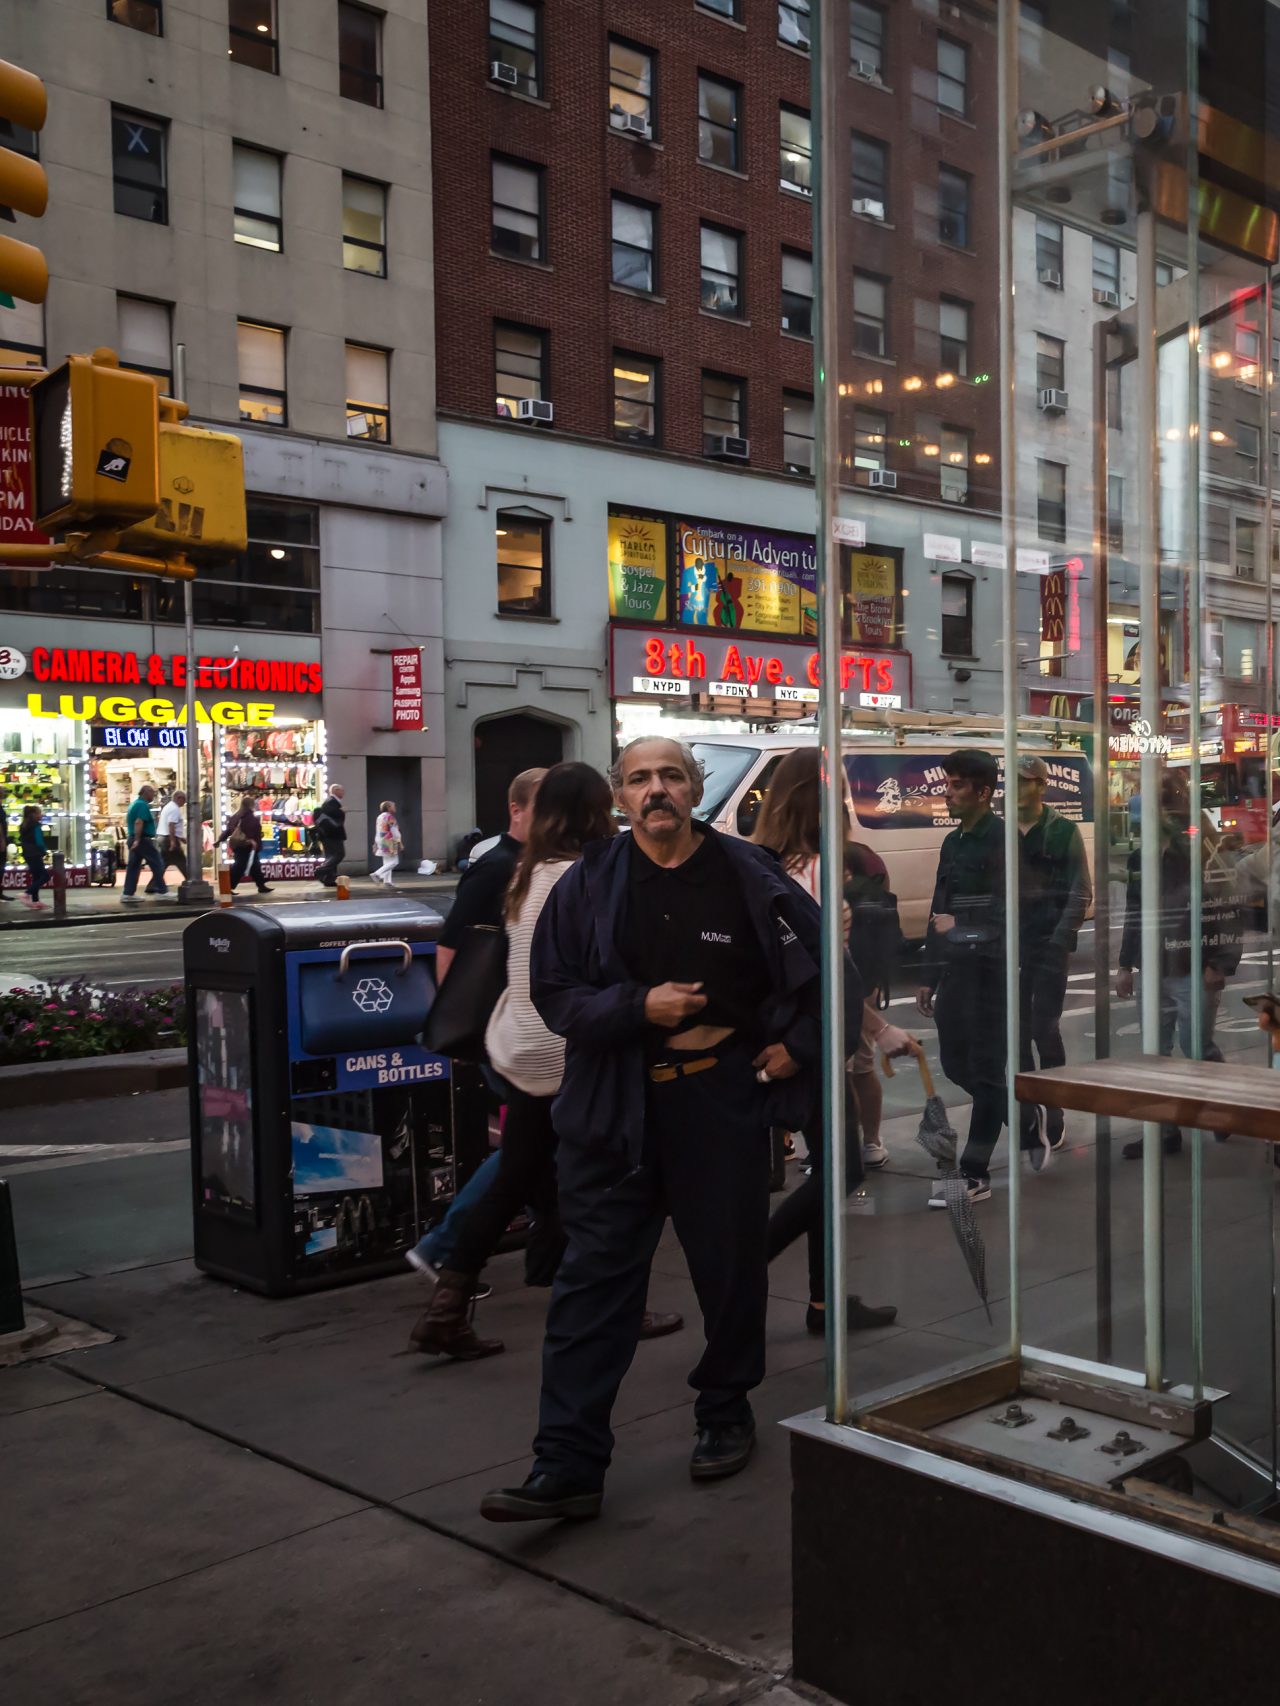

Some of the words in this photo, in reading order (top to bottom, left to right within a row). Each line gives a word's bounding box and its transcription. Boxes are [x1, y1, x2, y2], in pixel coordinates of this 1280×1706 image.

[696, 526, 725, 540] Embark
[727, 533, 737, 541] on
[738, 534, 743, 542] a
[681, 531, 748, 562] Cultural
[618, 563, 656, 580] Gospel
[632, 580, 655, 594] Jazz
[623, 594, 652, 610] Tours
[393, 654, 419, 666] REPAIR
[644, 637, 706, 679] 8th
[719, 644, 795, 685] Ave.
[807, 652, 894, 693] GFTS
[32, 646, 141, 686] CAMERA
[147, 653, 166, 686] &
[171, 655, 323, 694] EECTRONICS
[652, 680, 682, 692] NYPD
[725, 685, 751, 697] FDNY
[780, 689, 799, 700] NYC
[28, 692, 275, 728] LUGGAGE
[395, 709, 420, 721] PHOTO
[105, 727, 149, 747] BLOW
[1058, 781, 1082, 794] CORP.
[284, 863, 315, 878] CENTER
[74, 874, 87, 886] OFF
[319, 940, 347, 948] COFFEE
[345, 1054, 387, 1073] CANS
[390, 1051, 404, 1067] &
[377, 1062, 444, 1084] BOTTLES
